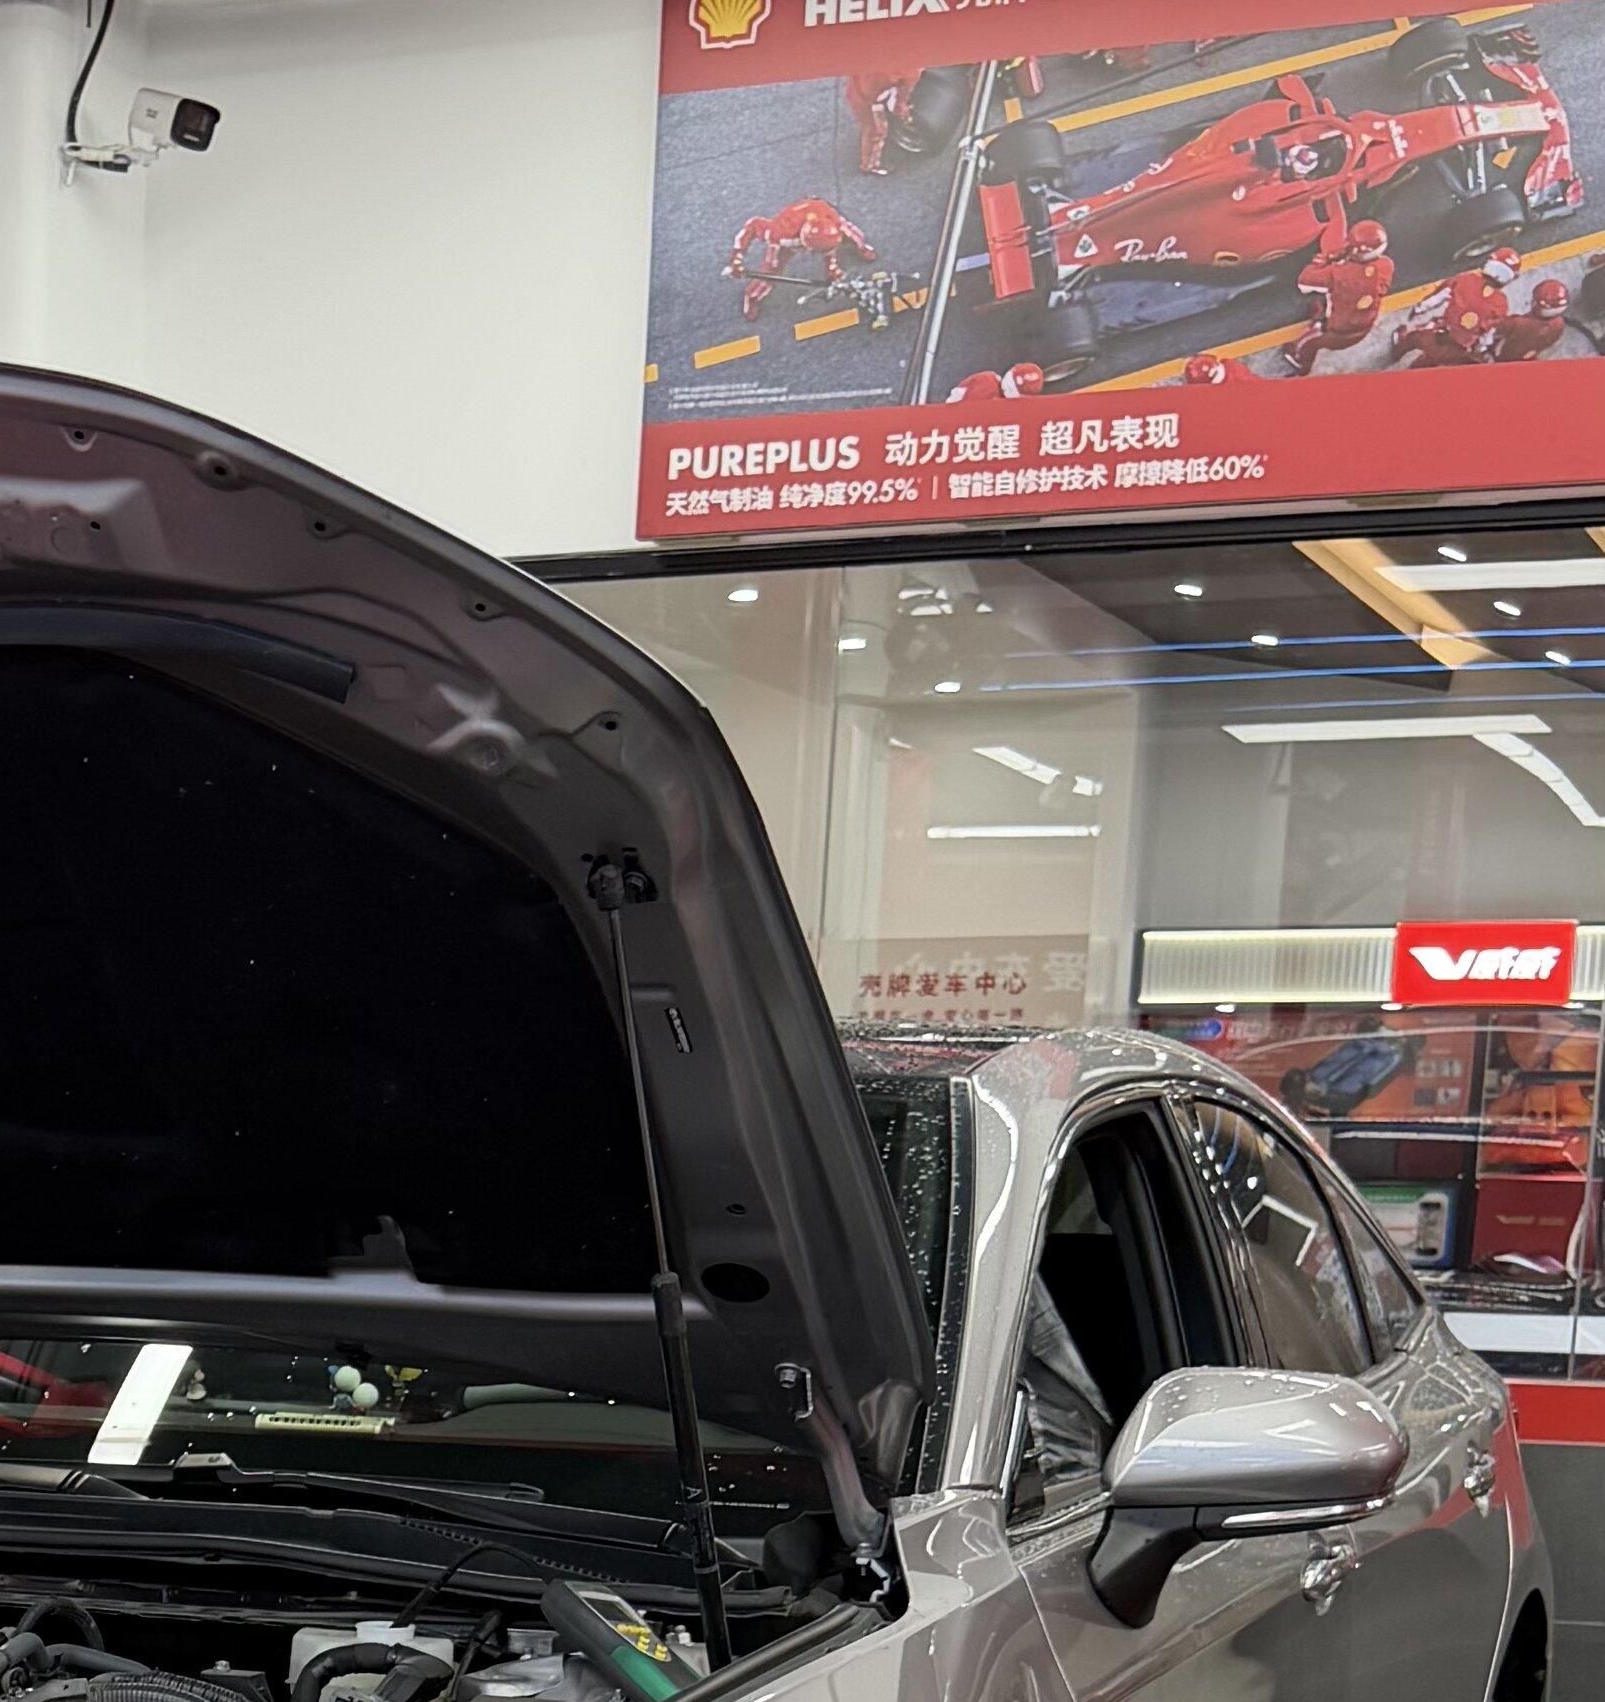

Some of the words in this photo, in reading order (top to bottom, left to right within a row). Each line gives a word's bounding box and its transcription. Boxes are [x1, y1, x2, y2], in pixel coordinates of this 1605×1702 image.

[668, 435, 860, 480] PUREPLUS
[885, 424, 1020, 467] 动力觉醒
[1039, 413, 1179, 456] 超凡表现
[666, 485, 774, 517] 天然气制油
[948, 464, 1108, 499] 智能自修护技术
